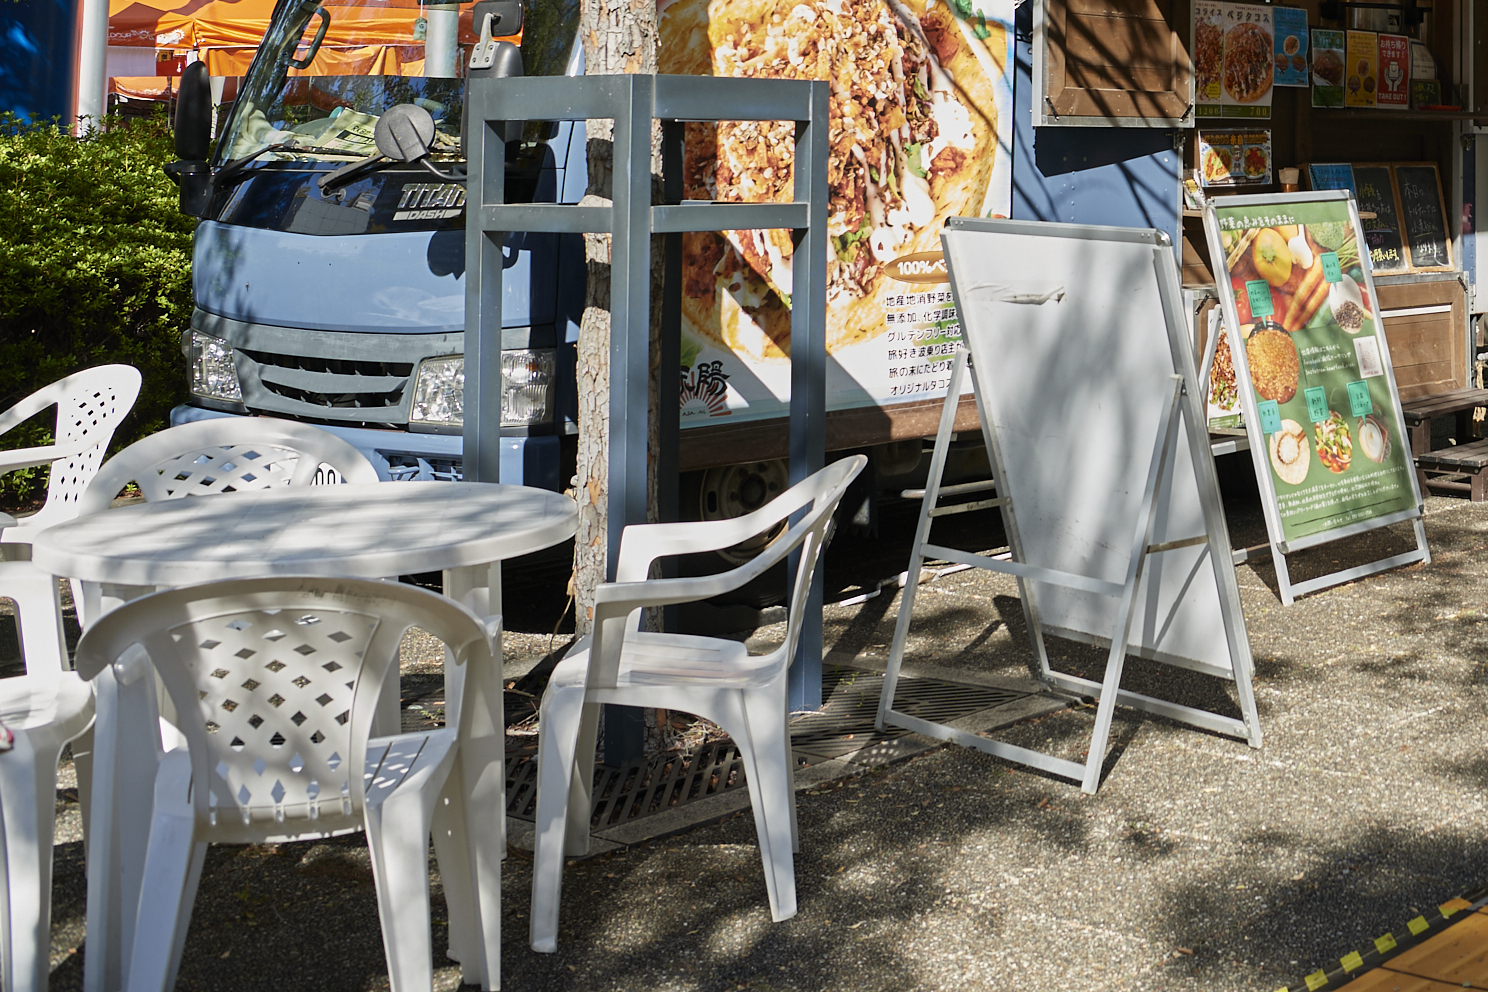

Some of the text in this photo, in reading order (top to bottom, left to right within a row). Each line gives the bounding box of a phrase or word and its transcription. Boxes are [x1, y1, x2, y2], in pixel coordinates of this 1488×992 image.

[1250, 107, 1268, 116] 700
[408, 209, 446, 221] DASH
[1219, 214, 1295, 230] 野菜の恵みをそのままに
